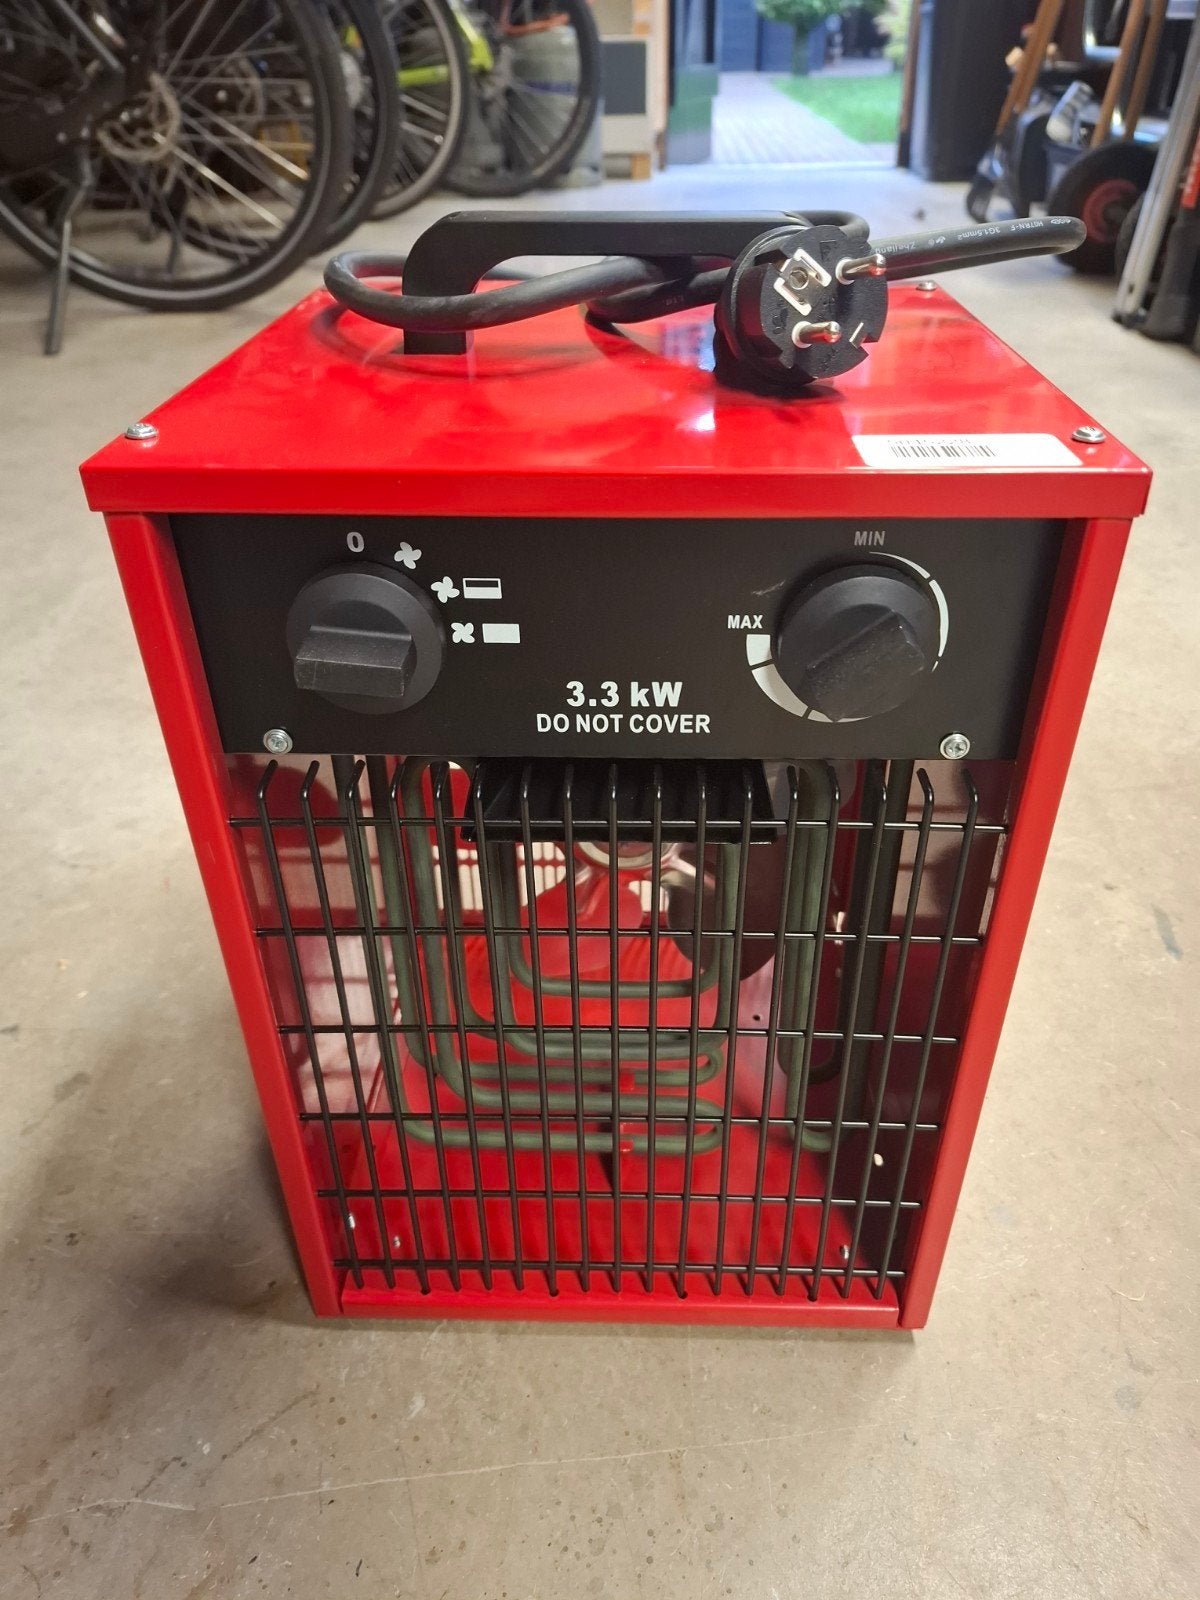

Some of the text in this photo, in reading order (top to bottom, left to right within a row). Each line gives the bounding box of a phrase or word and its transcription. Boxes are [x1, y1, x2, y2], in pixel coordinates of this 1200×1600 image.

[346, 531, 365, 553] 0
[854, 530, 886, 546] MIN
[727, 614, 763, 629] MAX
[566, 680, 683, 707] 3.3 kW
[536, 713, 711, 734] DO NOT COVER
